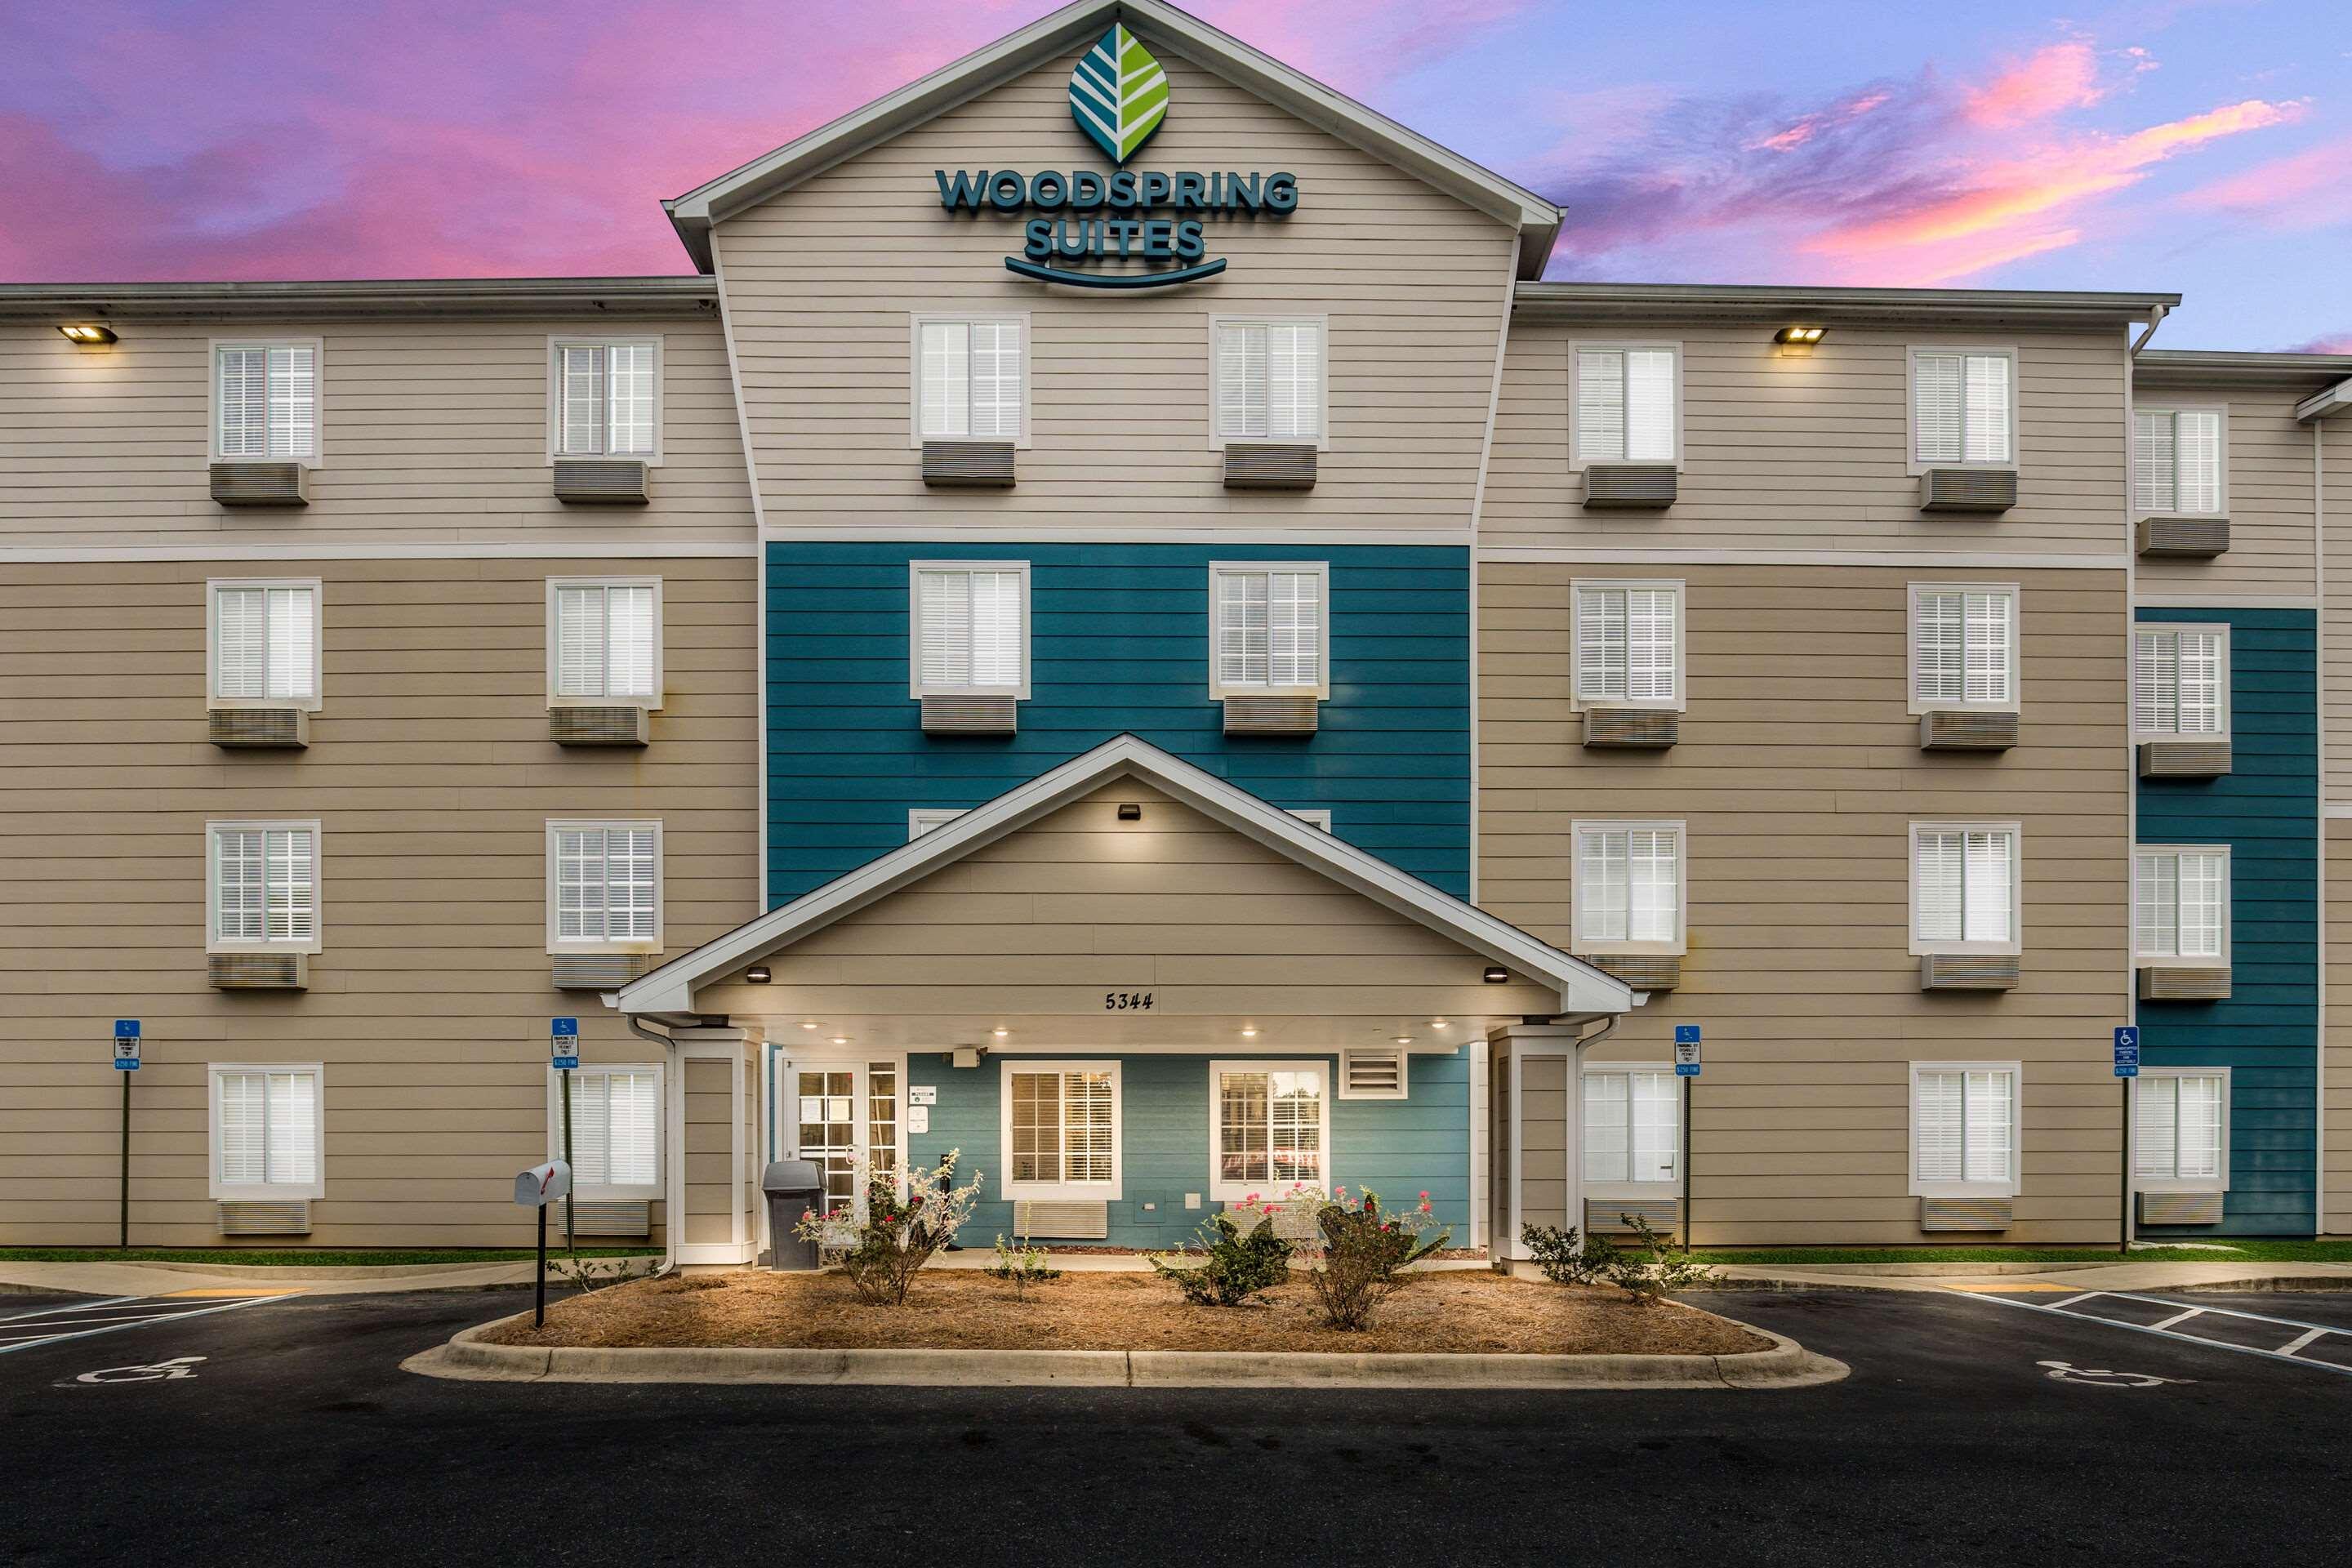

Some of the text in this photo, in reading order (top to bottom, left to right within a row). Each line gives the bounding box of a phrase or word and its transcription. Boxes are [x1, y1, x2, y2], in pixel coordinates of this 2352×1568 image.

[934, 169, 1298, 215] WOODSPRING
[1023, 218, 1205, 262] SUITES
[1105, 992, 1154, 1010] 5344
